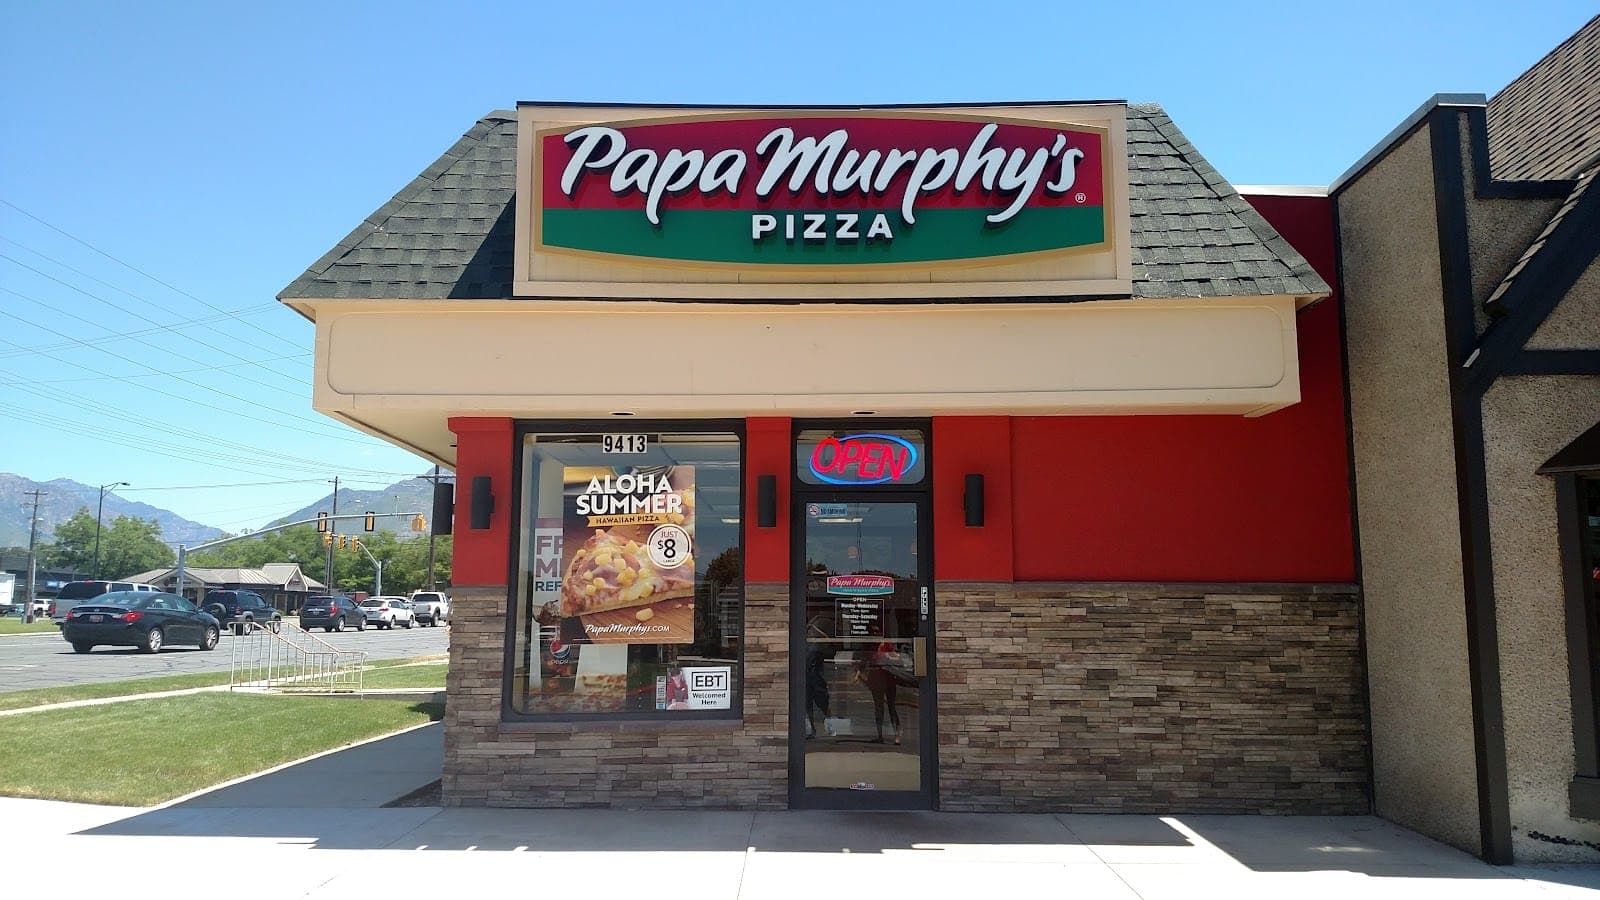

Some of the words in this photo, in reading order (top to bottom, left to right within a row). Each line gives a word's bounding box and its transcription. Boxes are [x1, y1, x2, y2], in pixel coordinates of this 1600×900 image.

[560, 125, 747, 226] Papa
[755, 123, 1085, 226] Murphy's
[752, 213, 894, 240] PIZZA
[604, 435, 646, 453] 9413
[811, 437, 908, 481] OPEN
[585, 474, 674, 494] ALOHA
[576, 493, 683, 515] SUMMER
[595, 516, 635, 524] HAWAIIAN
[660, 530, 679, 538] JUST
[830, 577, 852, 588] Papa
[695, 675, 724, 688] EBT
